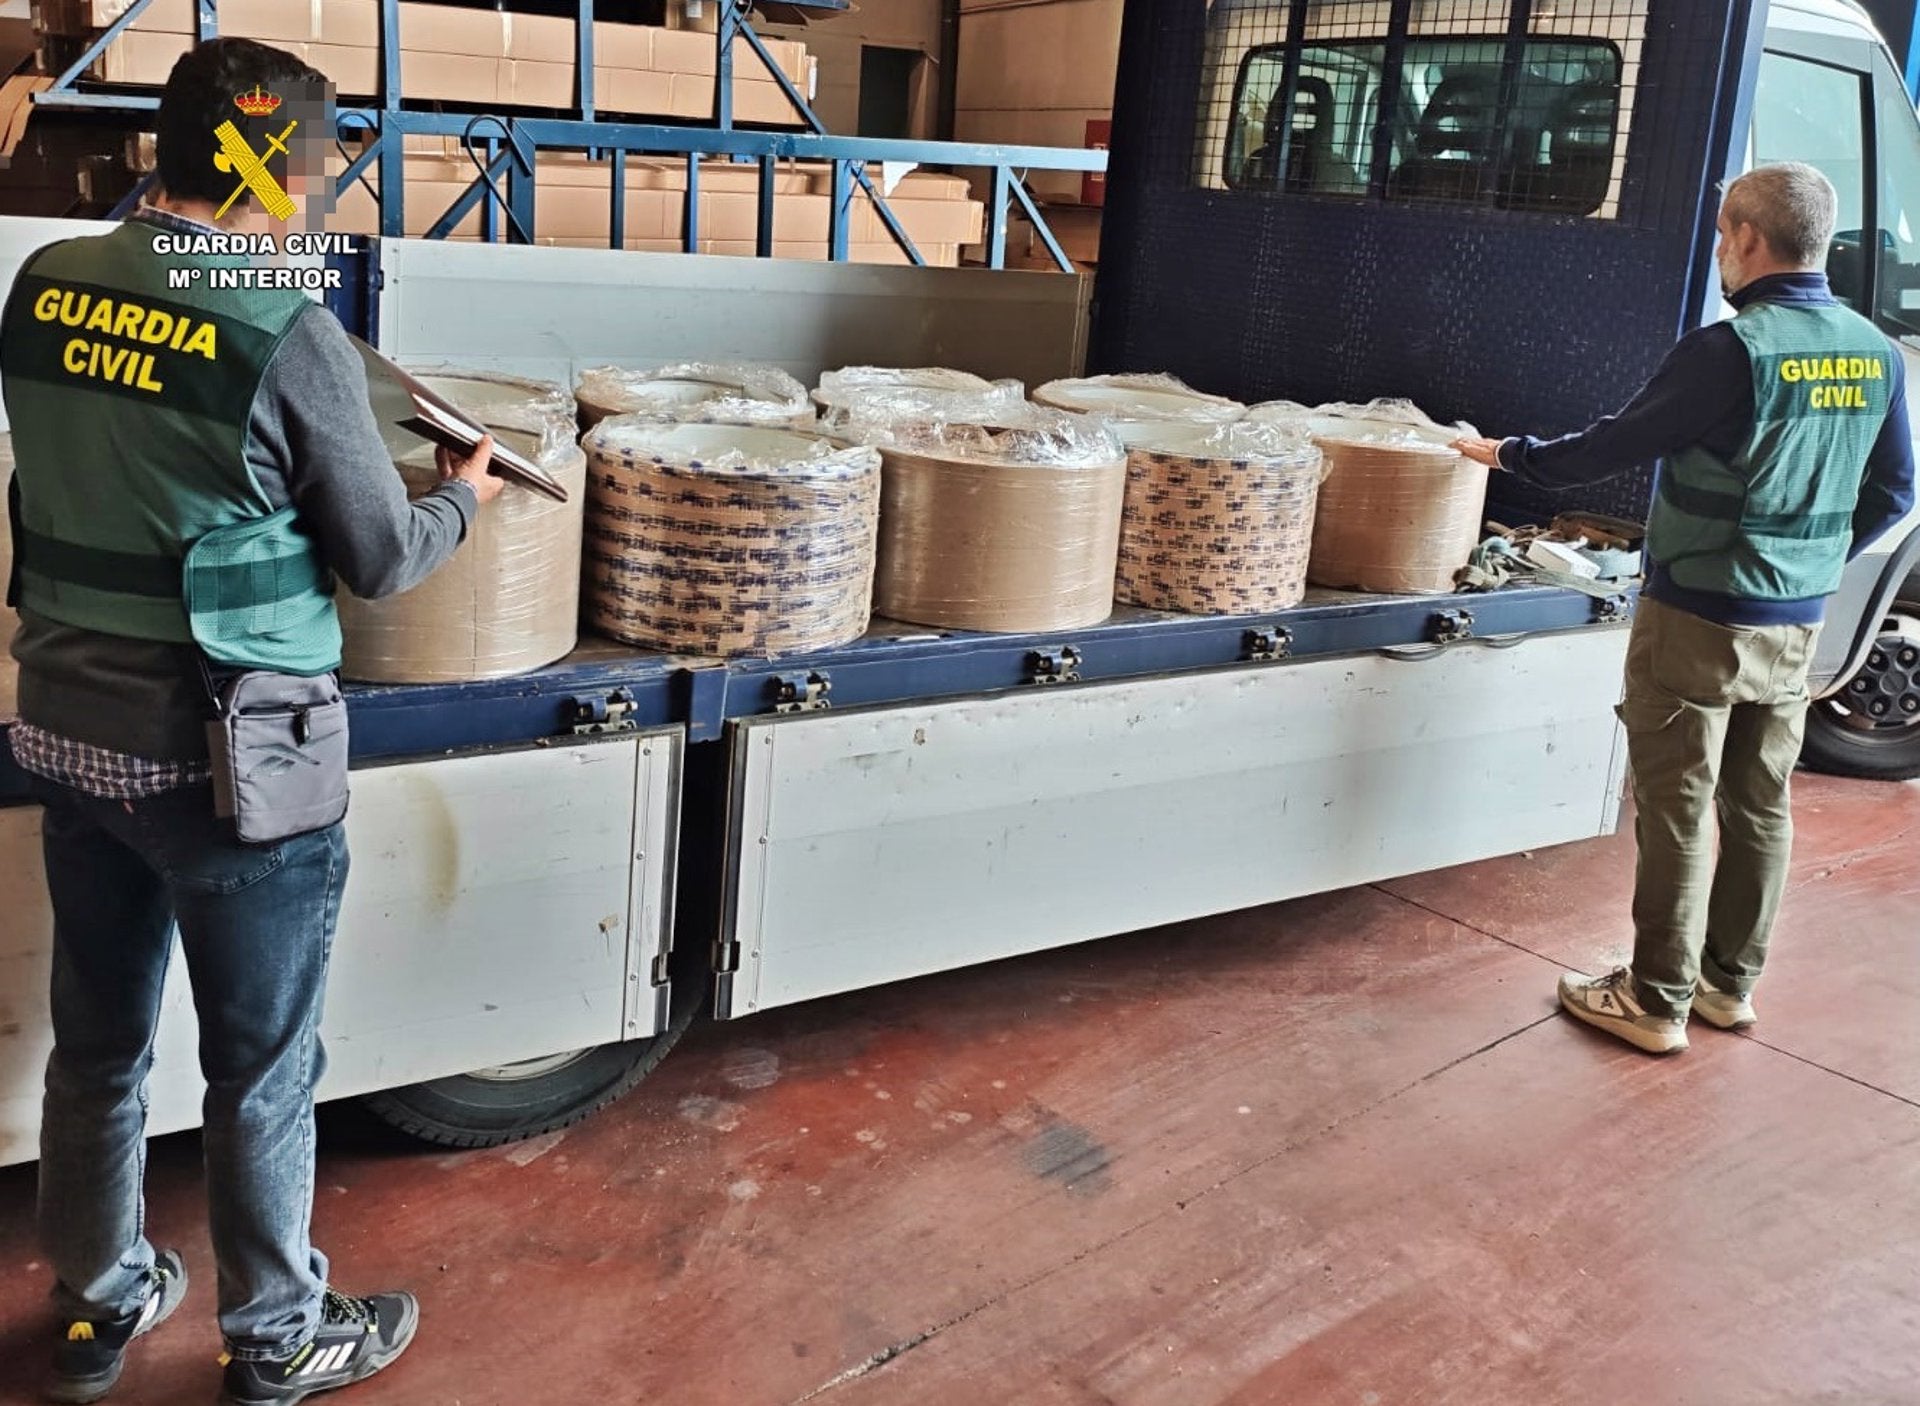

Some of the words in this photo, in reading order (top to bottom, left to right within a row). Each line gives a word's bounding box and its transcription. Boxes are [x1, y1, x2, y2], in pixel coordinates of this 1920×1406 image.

[33, 287, 217, 361] GUARDIA
[62, 338, 164, 394] CIVIL
[1780, 357, 1883, 383] GUARDIA
[1810, 385, 1868, 409] CIVIL
